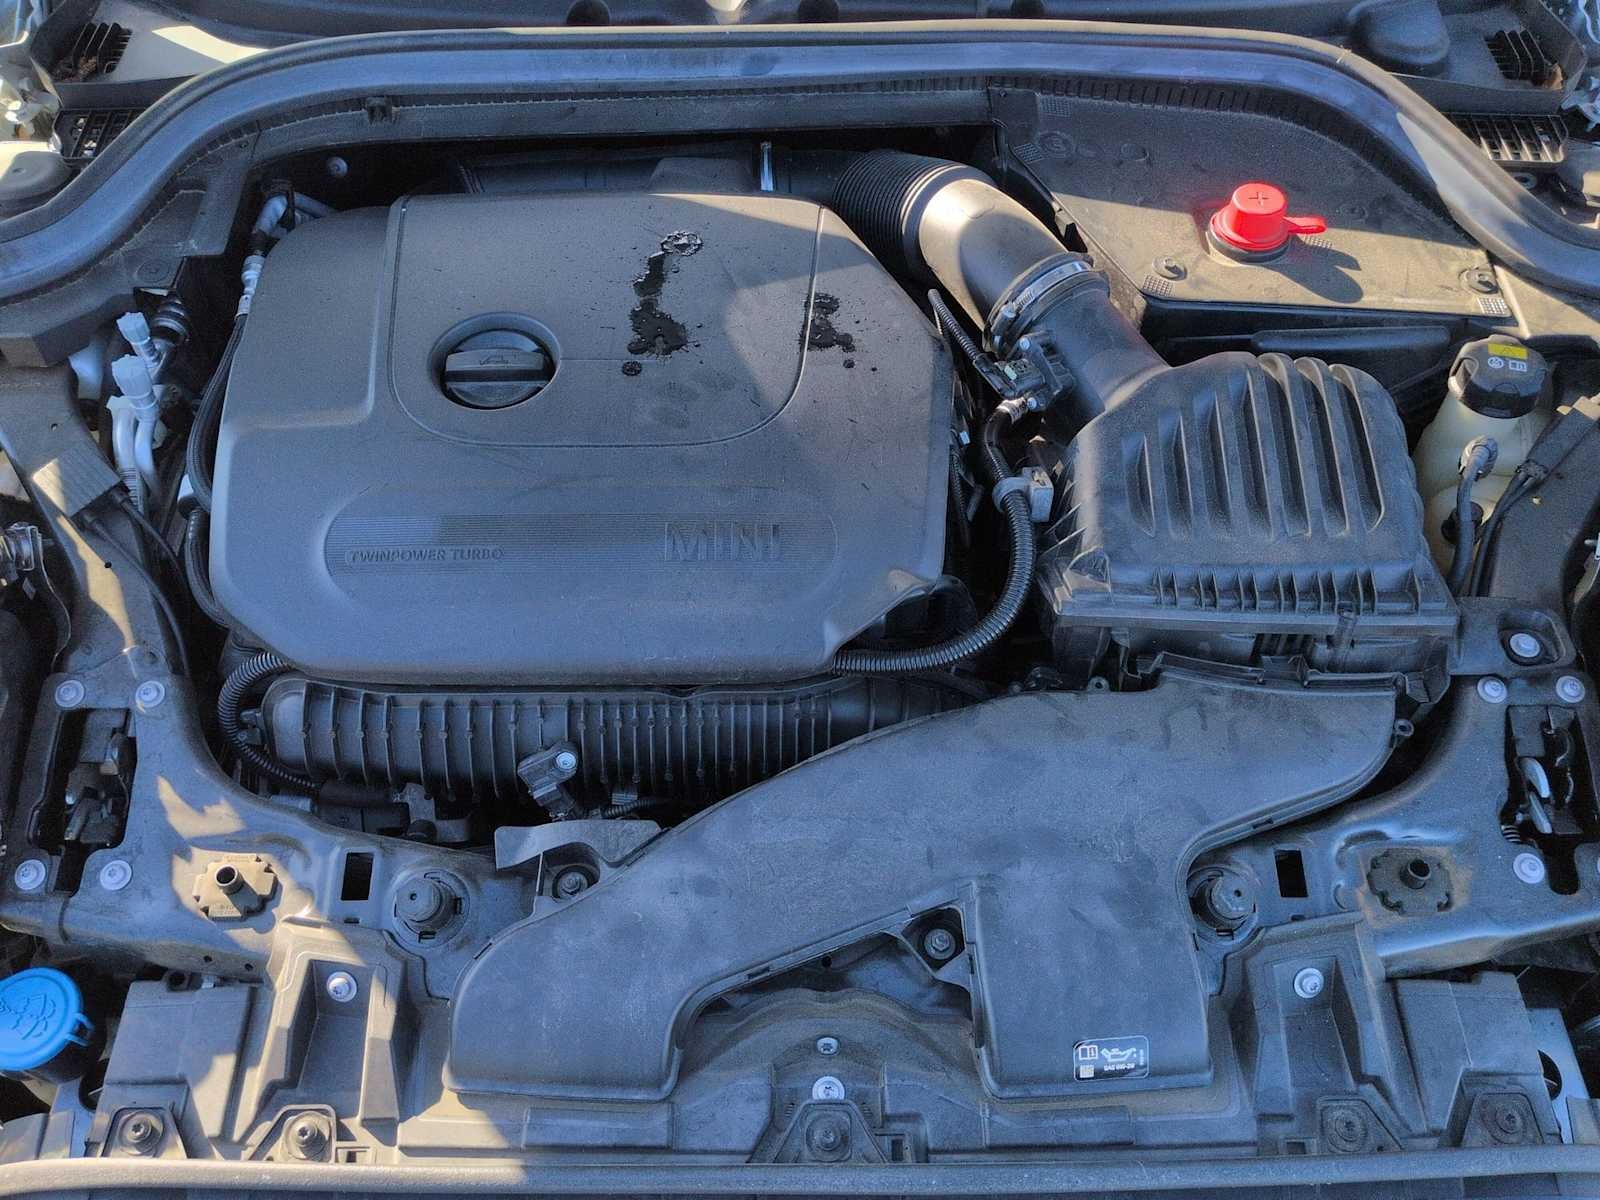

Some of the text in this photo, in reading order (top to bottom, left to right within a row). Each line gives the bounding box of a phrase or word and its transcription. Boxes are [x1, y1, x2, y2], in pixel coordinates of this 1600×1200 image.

[664, 521, 781, 561] MINI
[348, 548, 504, 562] TWINPOWER TURBO
